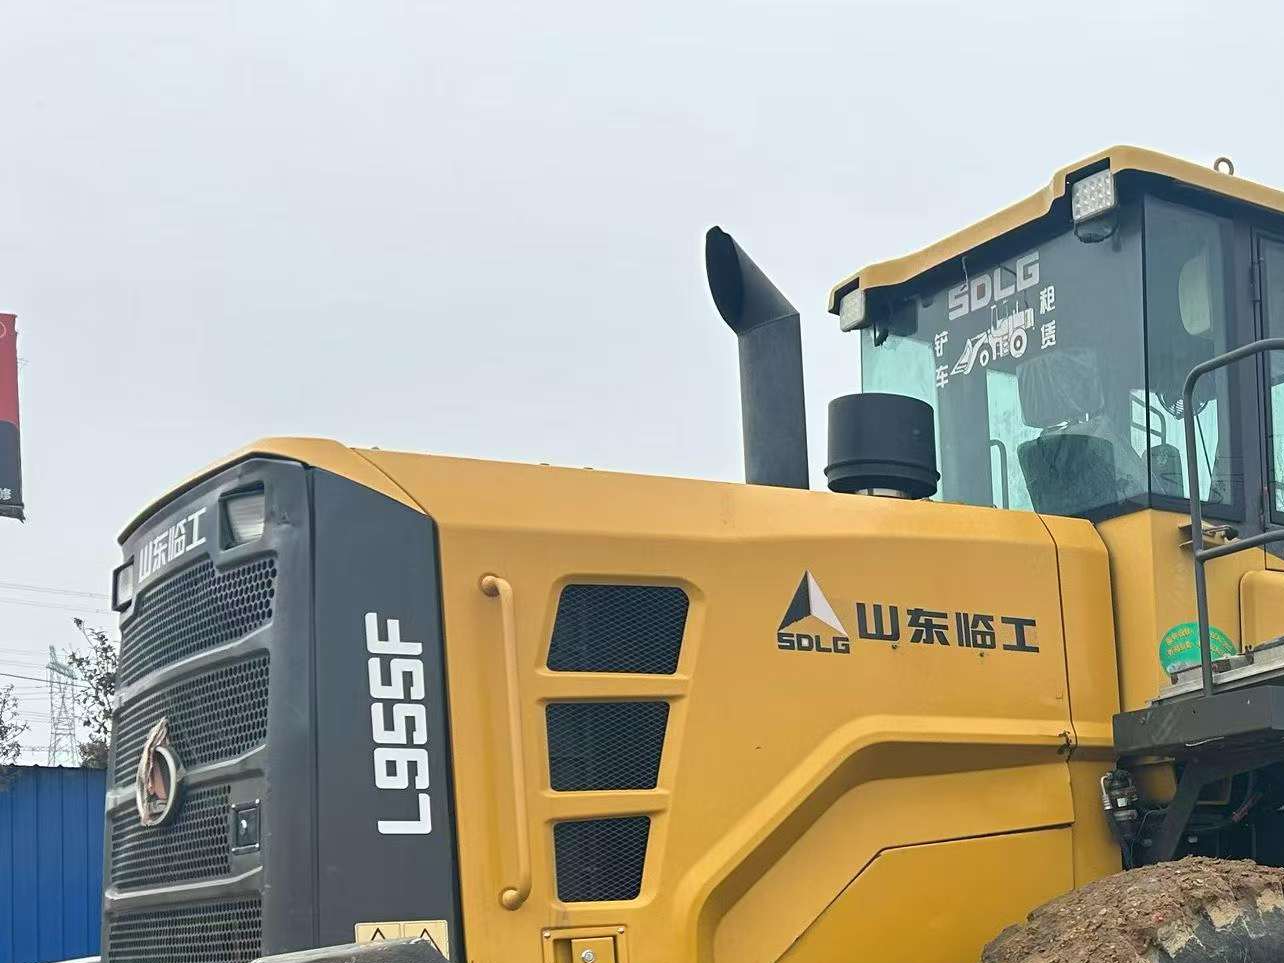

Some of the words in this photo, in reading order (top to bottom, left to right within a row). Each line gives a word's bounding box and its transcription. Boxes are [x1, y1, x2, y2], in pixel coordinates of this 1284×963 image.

[948, 251, 1040, 321] SDLG
[1039, 285, 1057, 350] 租赁
[934, 330, 950, 388] 铲车
[138, 506, 207, 584] 山东临工
[777, 632, 850, 655] SDLG
[855, 602, 1040, 654] 山东临工
[364, 612, 432, 836] L955F
